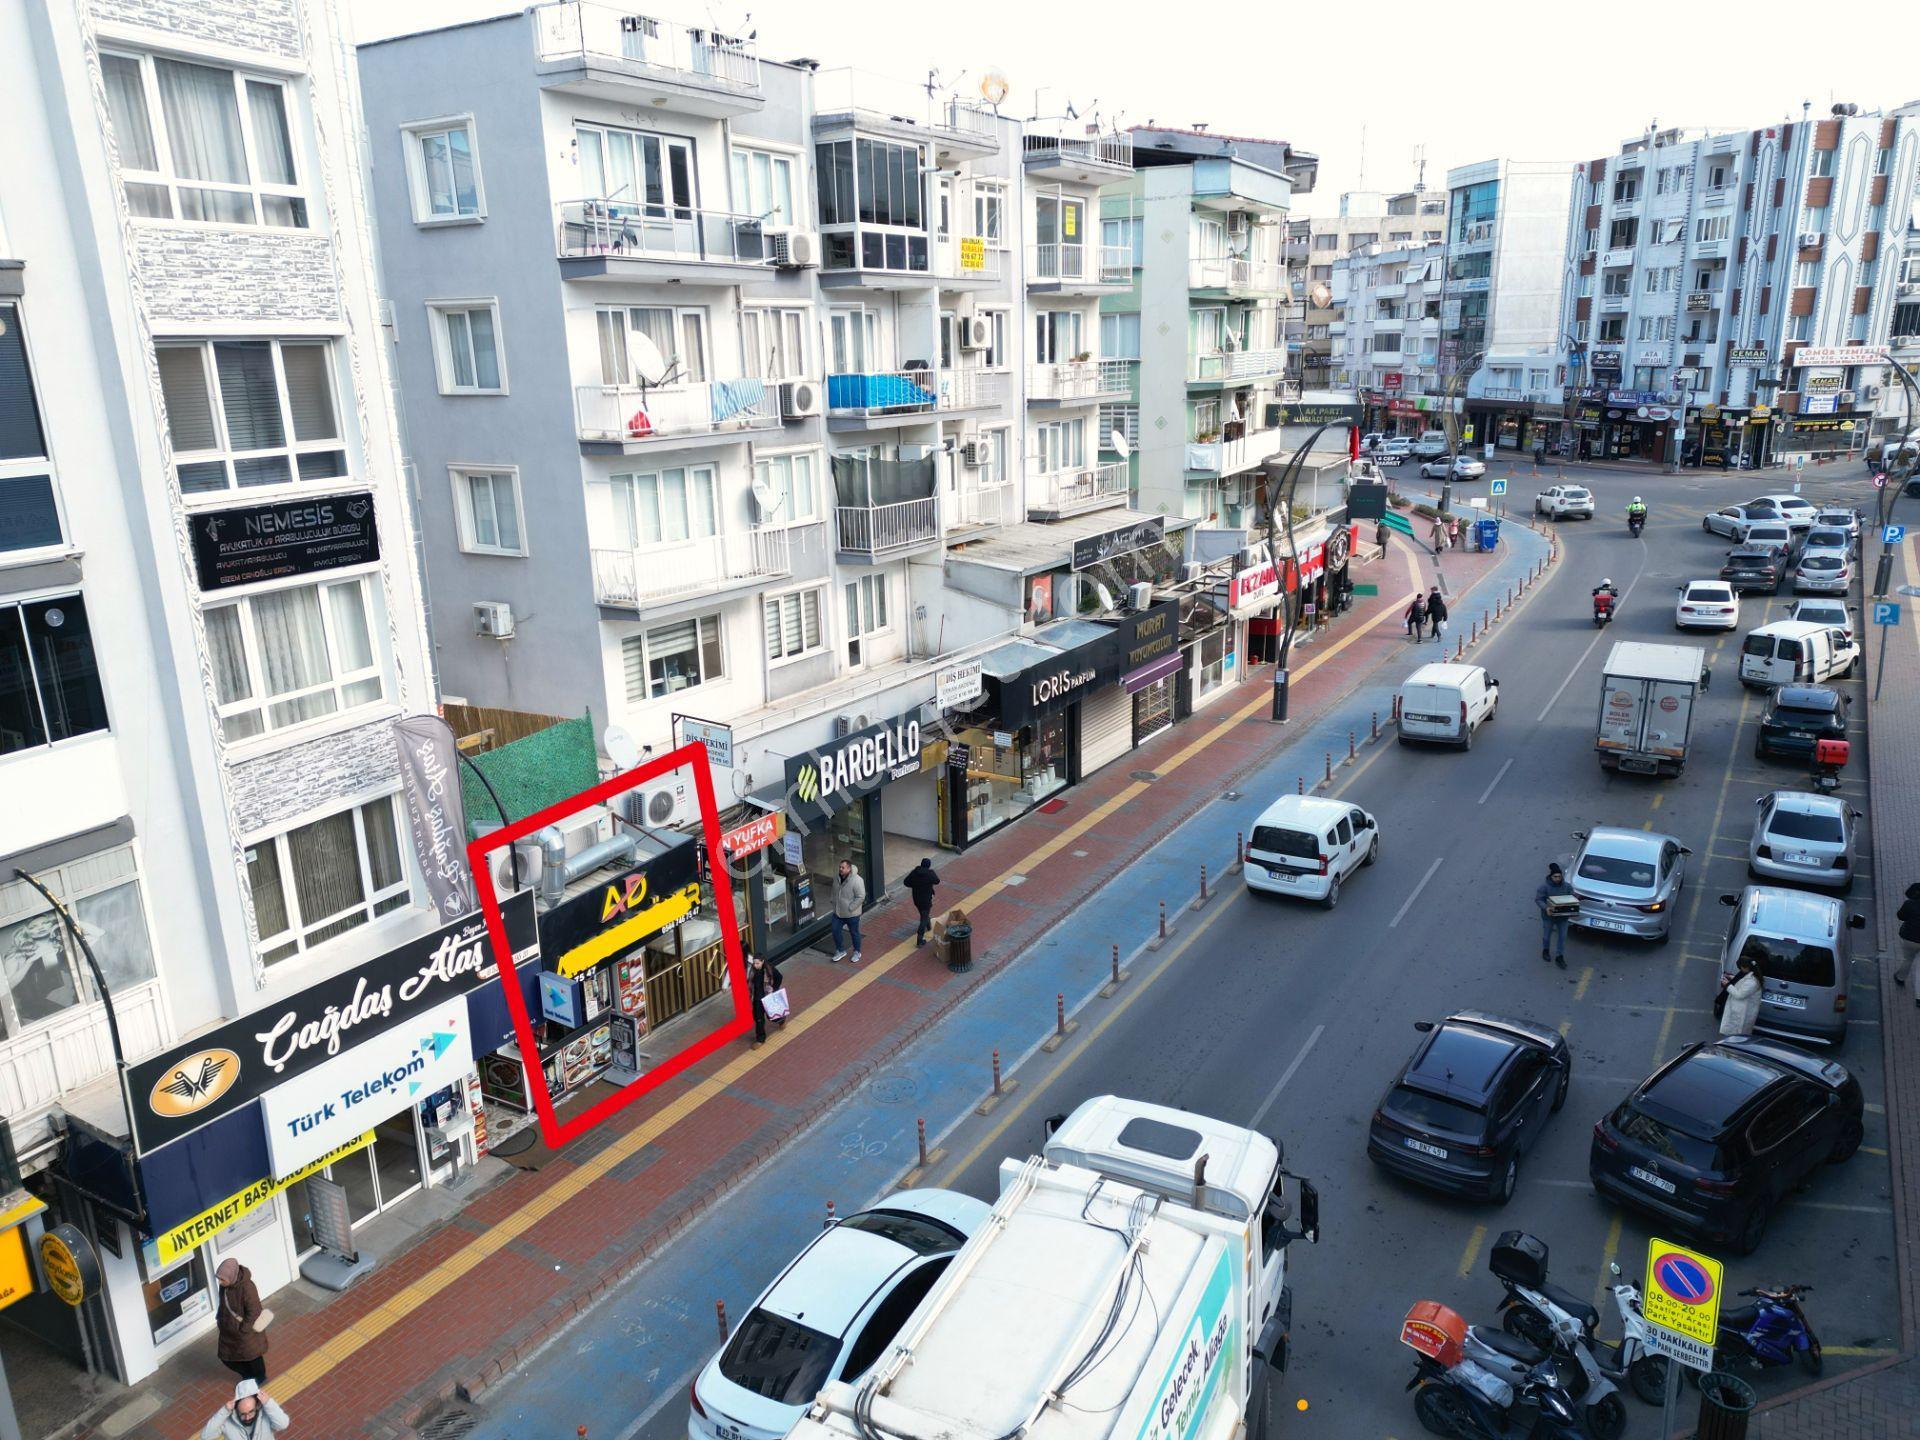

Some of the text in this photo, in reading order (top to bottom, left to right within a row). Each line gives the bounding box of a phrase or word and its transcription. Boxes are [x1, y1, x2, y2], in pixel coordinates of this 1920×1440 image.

[1319, 407, 1344, 415] PARTİ
[245, 503, 335, 535] NEMESİS
[1886, 527, 1897, 539] P
[219, 537, 263, 553] AVUKATLIK
[1136, 612, 1167, 640] MURAT
[1877, 605, 1886, 617] P
[1032, 669, 1071, 707] LORIS
[820, 720, 920, 797] BARGELLO
[733, 819, 774, 846] YUFKA
[586, 966, 597, 977] 47
[255, 934, 484, 1074] Çağdaş Ataş
[287, 1054, 426, 1139] Türk Telekom
[171, 1197, 241, 1252] İNTERNET
[1647, 1307, 1710, 1339] Park Yasaktır
[1648, 1300, 1711, 1330] Saatleri Arası
[1646, 1325, 1709, 1357] 30 DAKİKALIK
[1657, 1342, 1672, 1354] PARK
[1161, 1338, 1199, 1430] Gelecek
[1175, 1314, 1227, 1440] Temiz Aliağa
